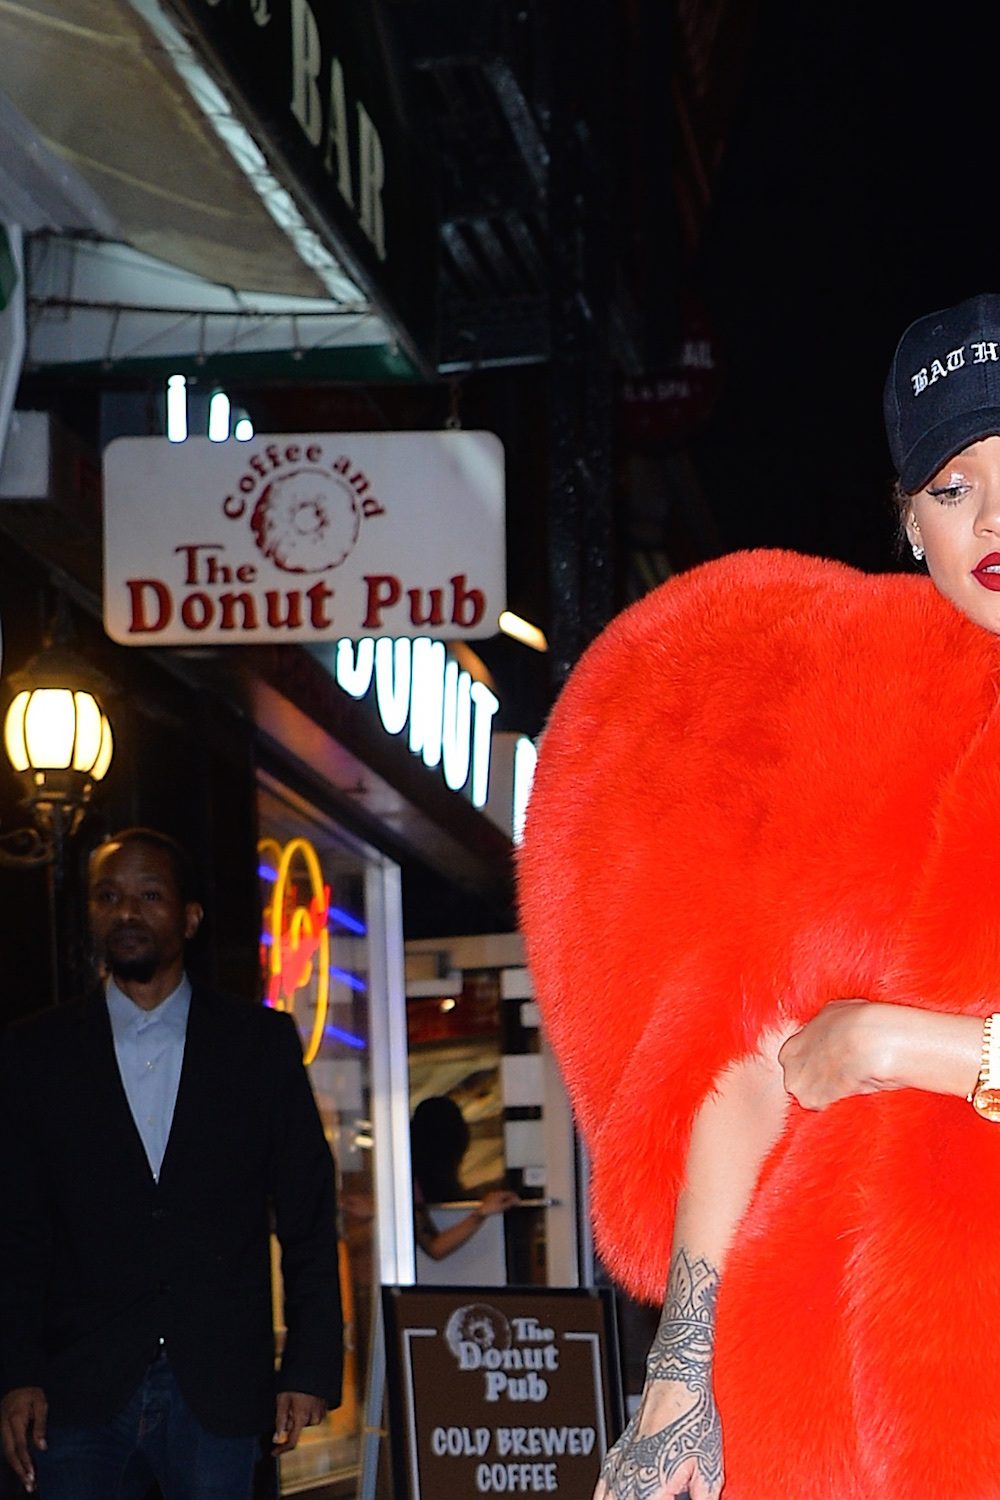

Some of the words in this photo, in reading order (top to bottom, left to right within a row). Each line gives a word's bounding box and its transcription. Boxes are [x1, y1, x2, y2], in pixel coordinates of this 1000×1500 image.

[289, 0, 387, 262] BAR
[223, 443, 323, 520] Coffee
[331, 455, 387, 519] and
[175, 543, 257, 585] The
[125, 579, 334, 633] Donut
[362, 573, 486, 629] Pub
[511, 1318, 555, 1342] The
[458, 1341, 559, 1371] Donut
[485, 1371, 548, 1401] Pub
[432, 1426, 491, 1457] COLD
[496, 1426, 596, 1456] BREWED
[477, 1463, 558, 1492] COFFEE
